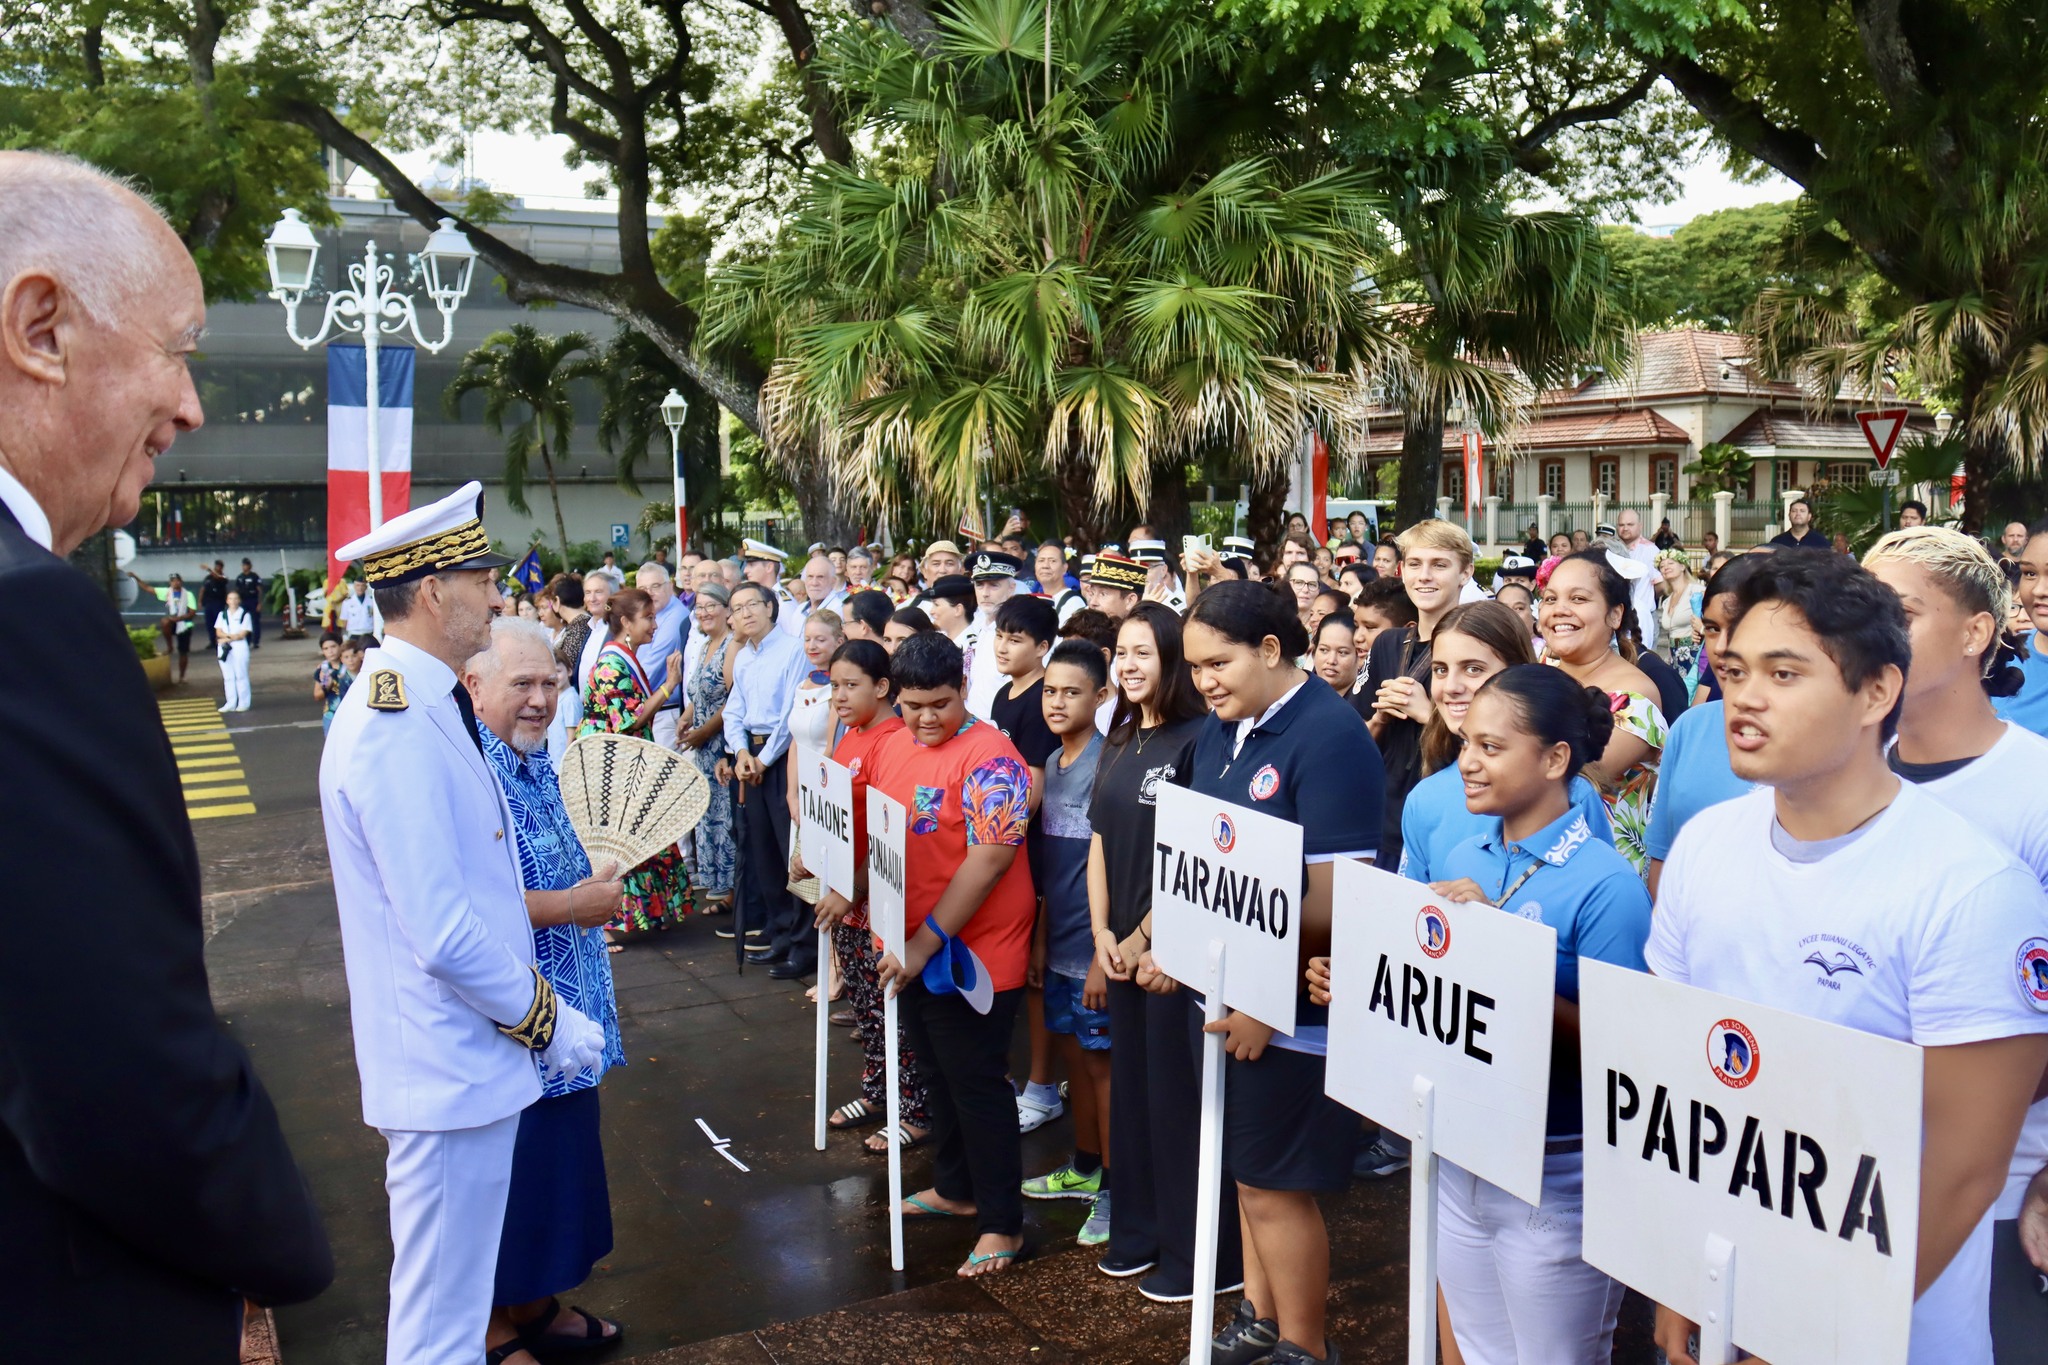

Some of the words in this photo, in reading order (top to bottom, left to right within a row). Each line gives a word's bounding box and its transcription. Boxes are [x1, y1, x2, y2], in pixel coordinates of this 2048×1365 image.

[612, 525, 625, 542] P
[801, 785, 849, 844] TAAONE
[868, 833, 904, 898] PUNAAUIA
[1156, 842, 1289, 940] TARAVAO
[1368, 953, 1496, 1066] ARUE
[1817, 976, 1842, 991] PAPARA
[1721, 1020, 1730, 1029] LE
[1731, 1020, 1759, 1056] SOUVENIR
[1715, 1067, 1750, 1089] FRANÇAIS
[1607, 1068, 1893, 1257] PAPARA
